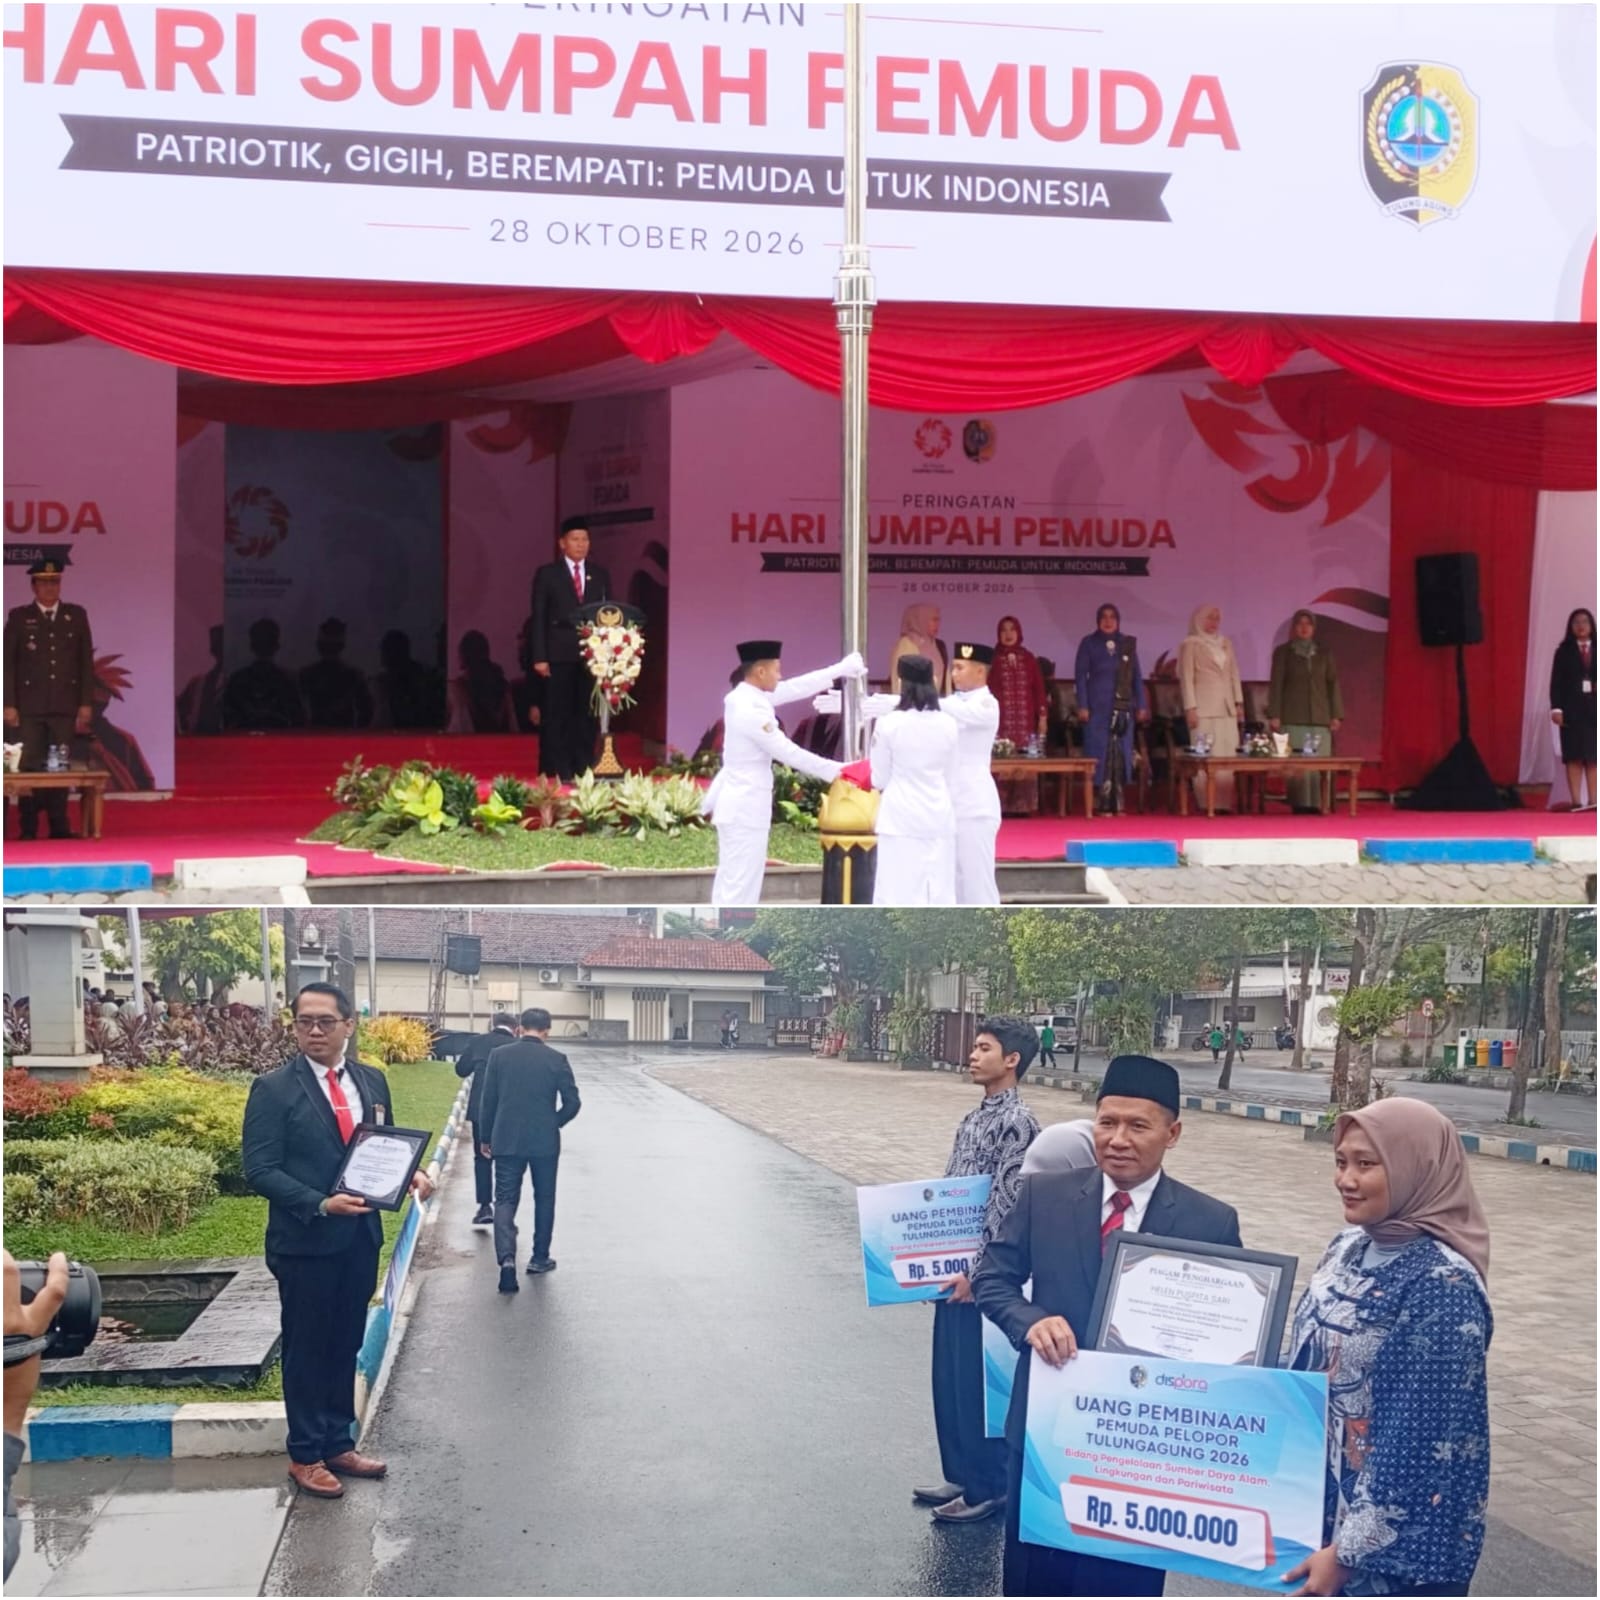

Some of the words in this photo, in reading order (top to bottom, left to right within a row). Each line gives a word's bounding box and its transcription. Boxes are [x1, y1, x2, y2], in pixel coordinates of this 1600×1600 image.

[3, 3, 258, 97] HARI
[300, 18, 768, 127] SUMPAH
[808, 52, 1241, 151] PEMUDA
[135, 131, 332, 174] PATRIOTIK,
[344, 143, 454, 182] GIGIH,
[467, 151, 665, 188] BEREMPATI:
[676, 161, 815, 196] PEMUDA
[826, 169, 933, 200] UTUK
[943, 174, 1111, 209] INDONESIA
[489, 218, 531, 244] 28
[547, 221, 708, 252] OKTOBER
[724, 229, 806, 256] 2026
[902, 494, 1015, 509] PERINGATAN
[4, 500, 107, 535] UDA
[731, 512, 826, 543] HARI
[838, 514, 1000, 546] UMPAH
[1013, 516, 1176, 549] PEMUDA
[784, 555, 840, 569] PATRIOTI
[967, 558, 1018, 571] PEMUDA
[1021, 559, 1060, 571] UNTUK
[1063, 560, 1127, 572] INDONESIA
[920, 582, 979, 593] OKTOBER
[892, 1210, 928, 1223] UANG
[931, 1205, 987, 1219] PEMBINA
[907, 1220, 946, 1231] PEMUDA
[949, 1215, 985, 1227] PELOPO
[902, 1227, 974, 1241] TULUNGAGUNG
[908, 1263, 929, 1280] Rp.
[932, 1257, 969, 1276] 5.000
[1182, 1272, 1245, 1289] PENGHARGAAN
[1155, 1373, 1208, 1391] dispora
[1076, 1395, 1132, 1416] UANG
[1138, 1401, 1266, 1434] PEMBINAAN
[1096, 1417, 1160, 1438] PEMUDA
[1164, 1427, 1240, 1449] PELOPOR
[1086, 1432, 1205, 1461] TULUNGAGUNG
[1210, 1450, 1250, 1467] 2026
[1065, 1448, 1099, 1463] Bidang
[1101, 1452, 1163, 1471] Pengelolaan
[1165, 1462, 1205, 1477] Sumber
[1208, 1469, 1236, 1483] Daya
[1095, 1465, 1153, 1485] Lingkungan
[1155, 1474, 1175, 1486] dan
[1177, 1477, 1235, 1495] Pariwisata
[1087, 1495, 1118, 1528] Rp.
[1125, 1502, 1239, 1547] 5.000.000
